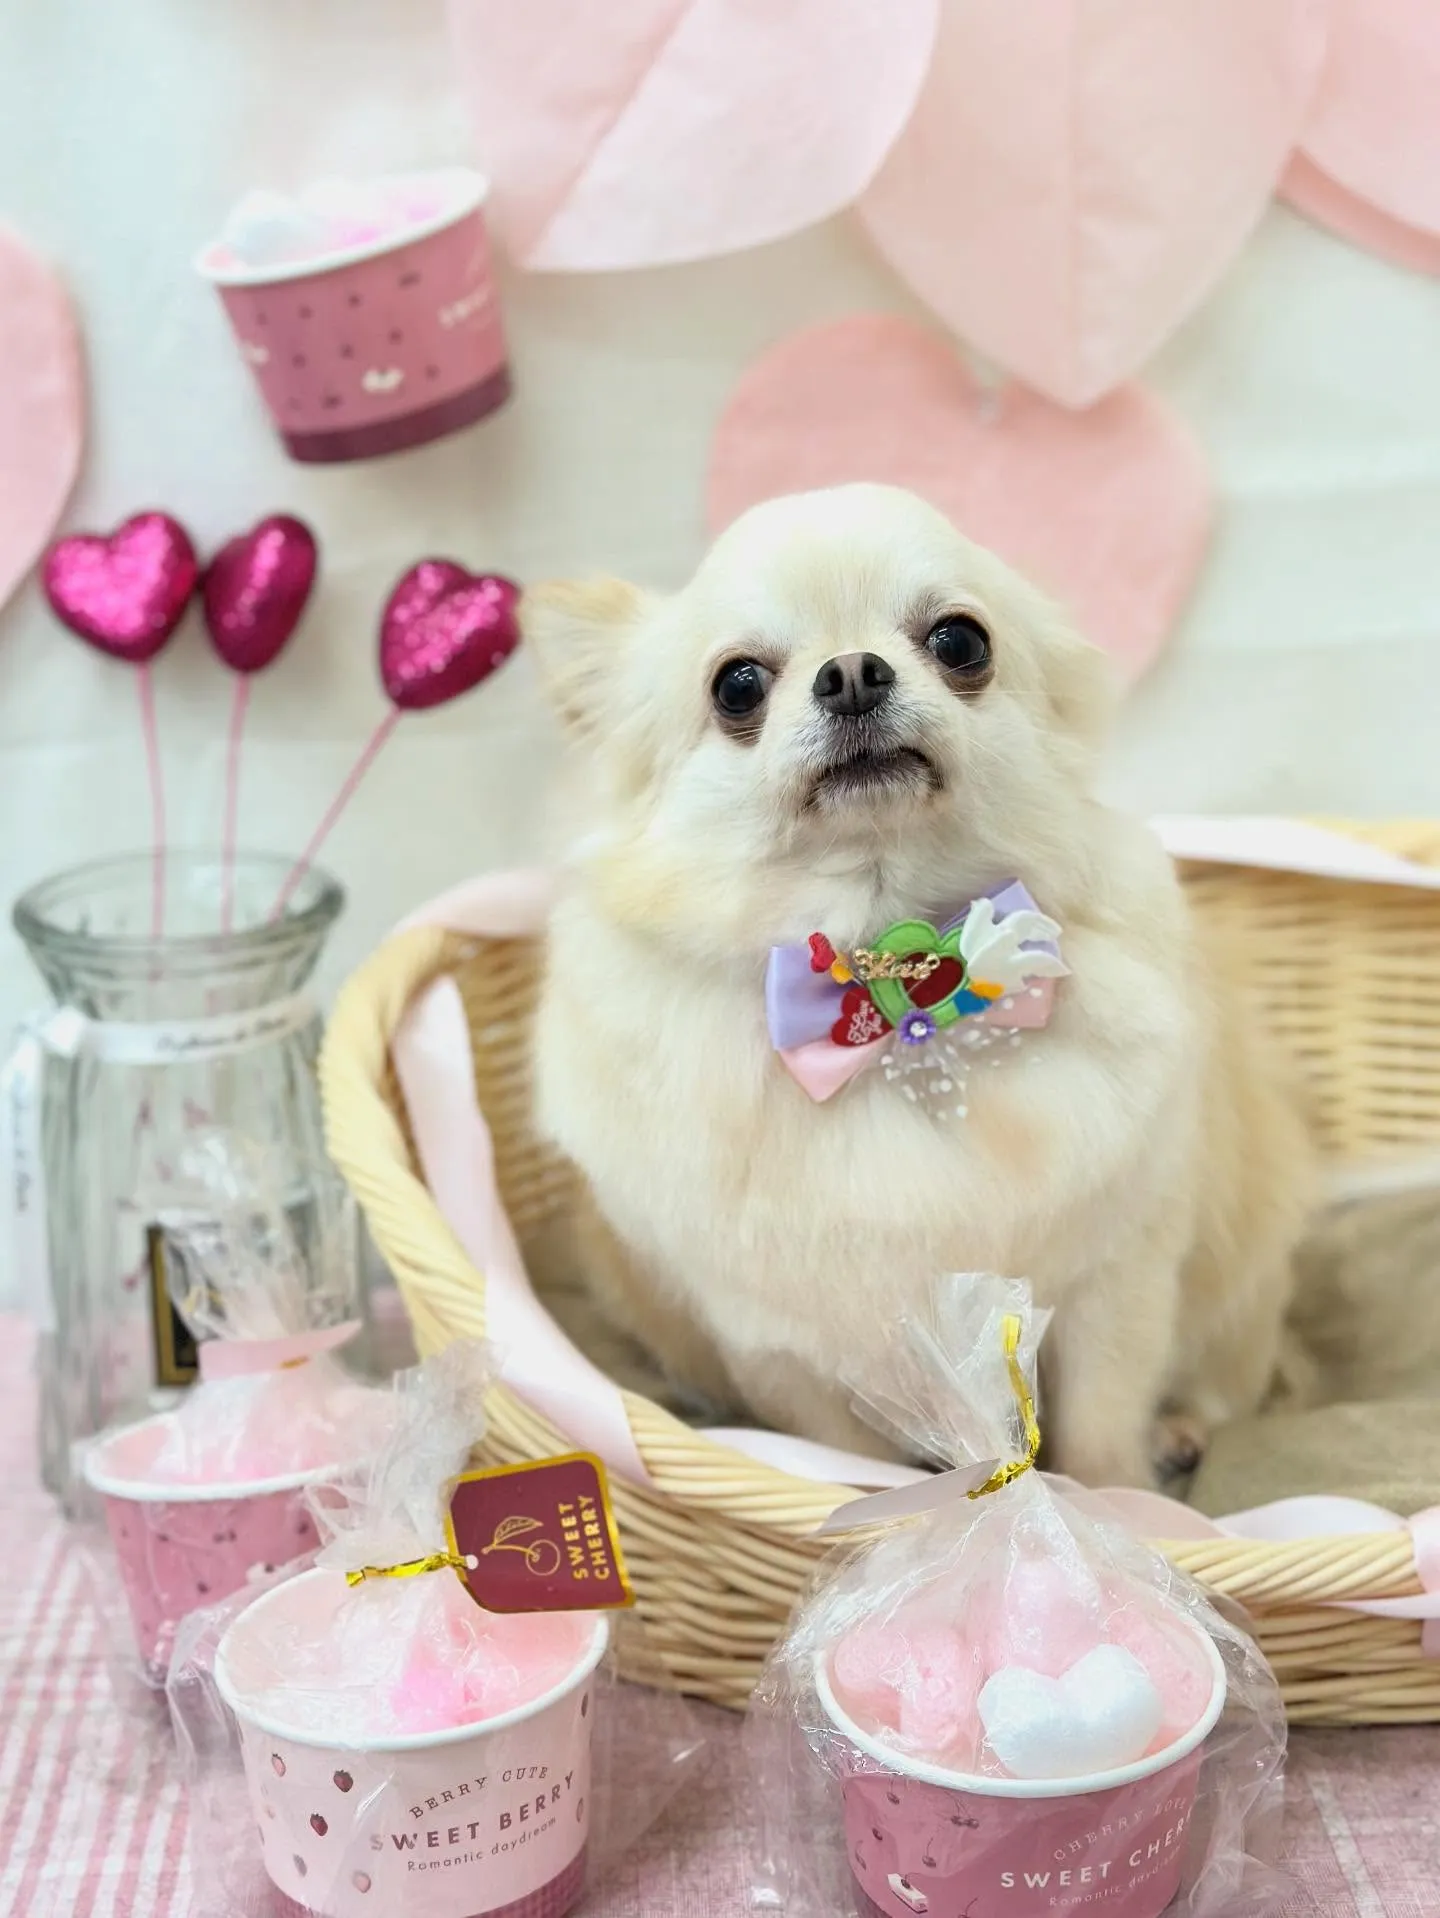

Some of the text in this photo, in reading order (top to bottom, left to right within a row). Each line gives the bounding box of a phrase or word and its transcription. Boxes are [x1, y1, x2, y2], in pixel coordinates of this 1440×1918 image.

[558, 1503, 589, 1580] SWEET
[577, 1495, 610, 1580] CHERRY
[369, 1770, 575, 1852] SWEET BERRY
[408, 1765, 549, 1819] BERRY CUTE
[407, 1816, 557, 1872] Romantic daydream
[1000, 1859, 1112, 1890] SWEET
[1049, 1884, 1122, 1907] Romantic
